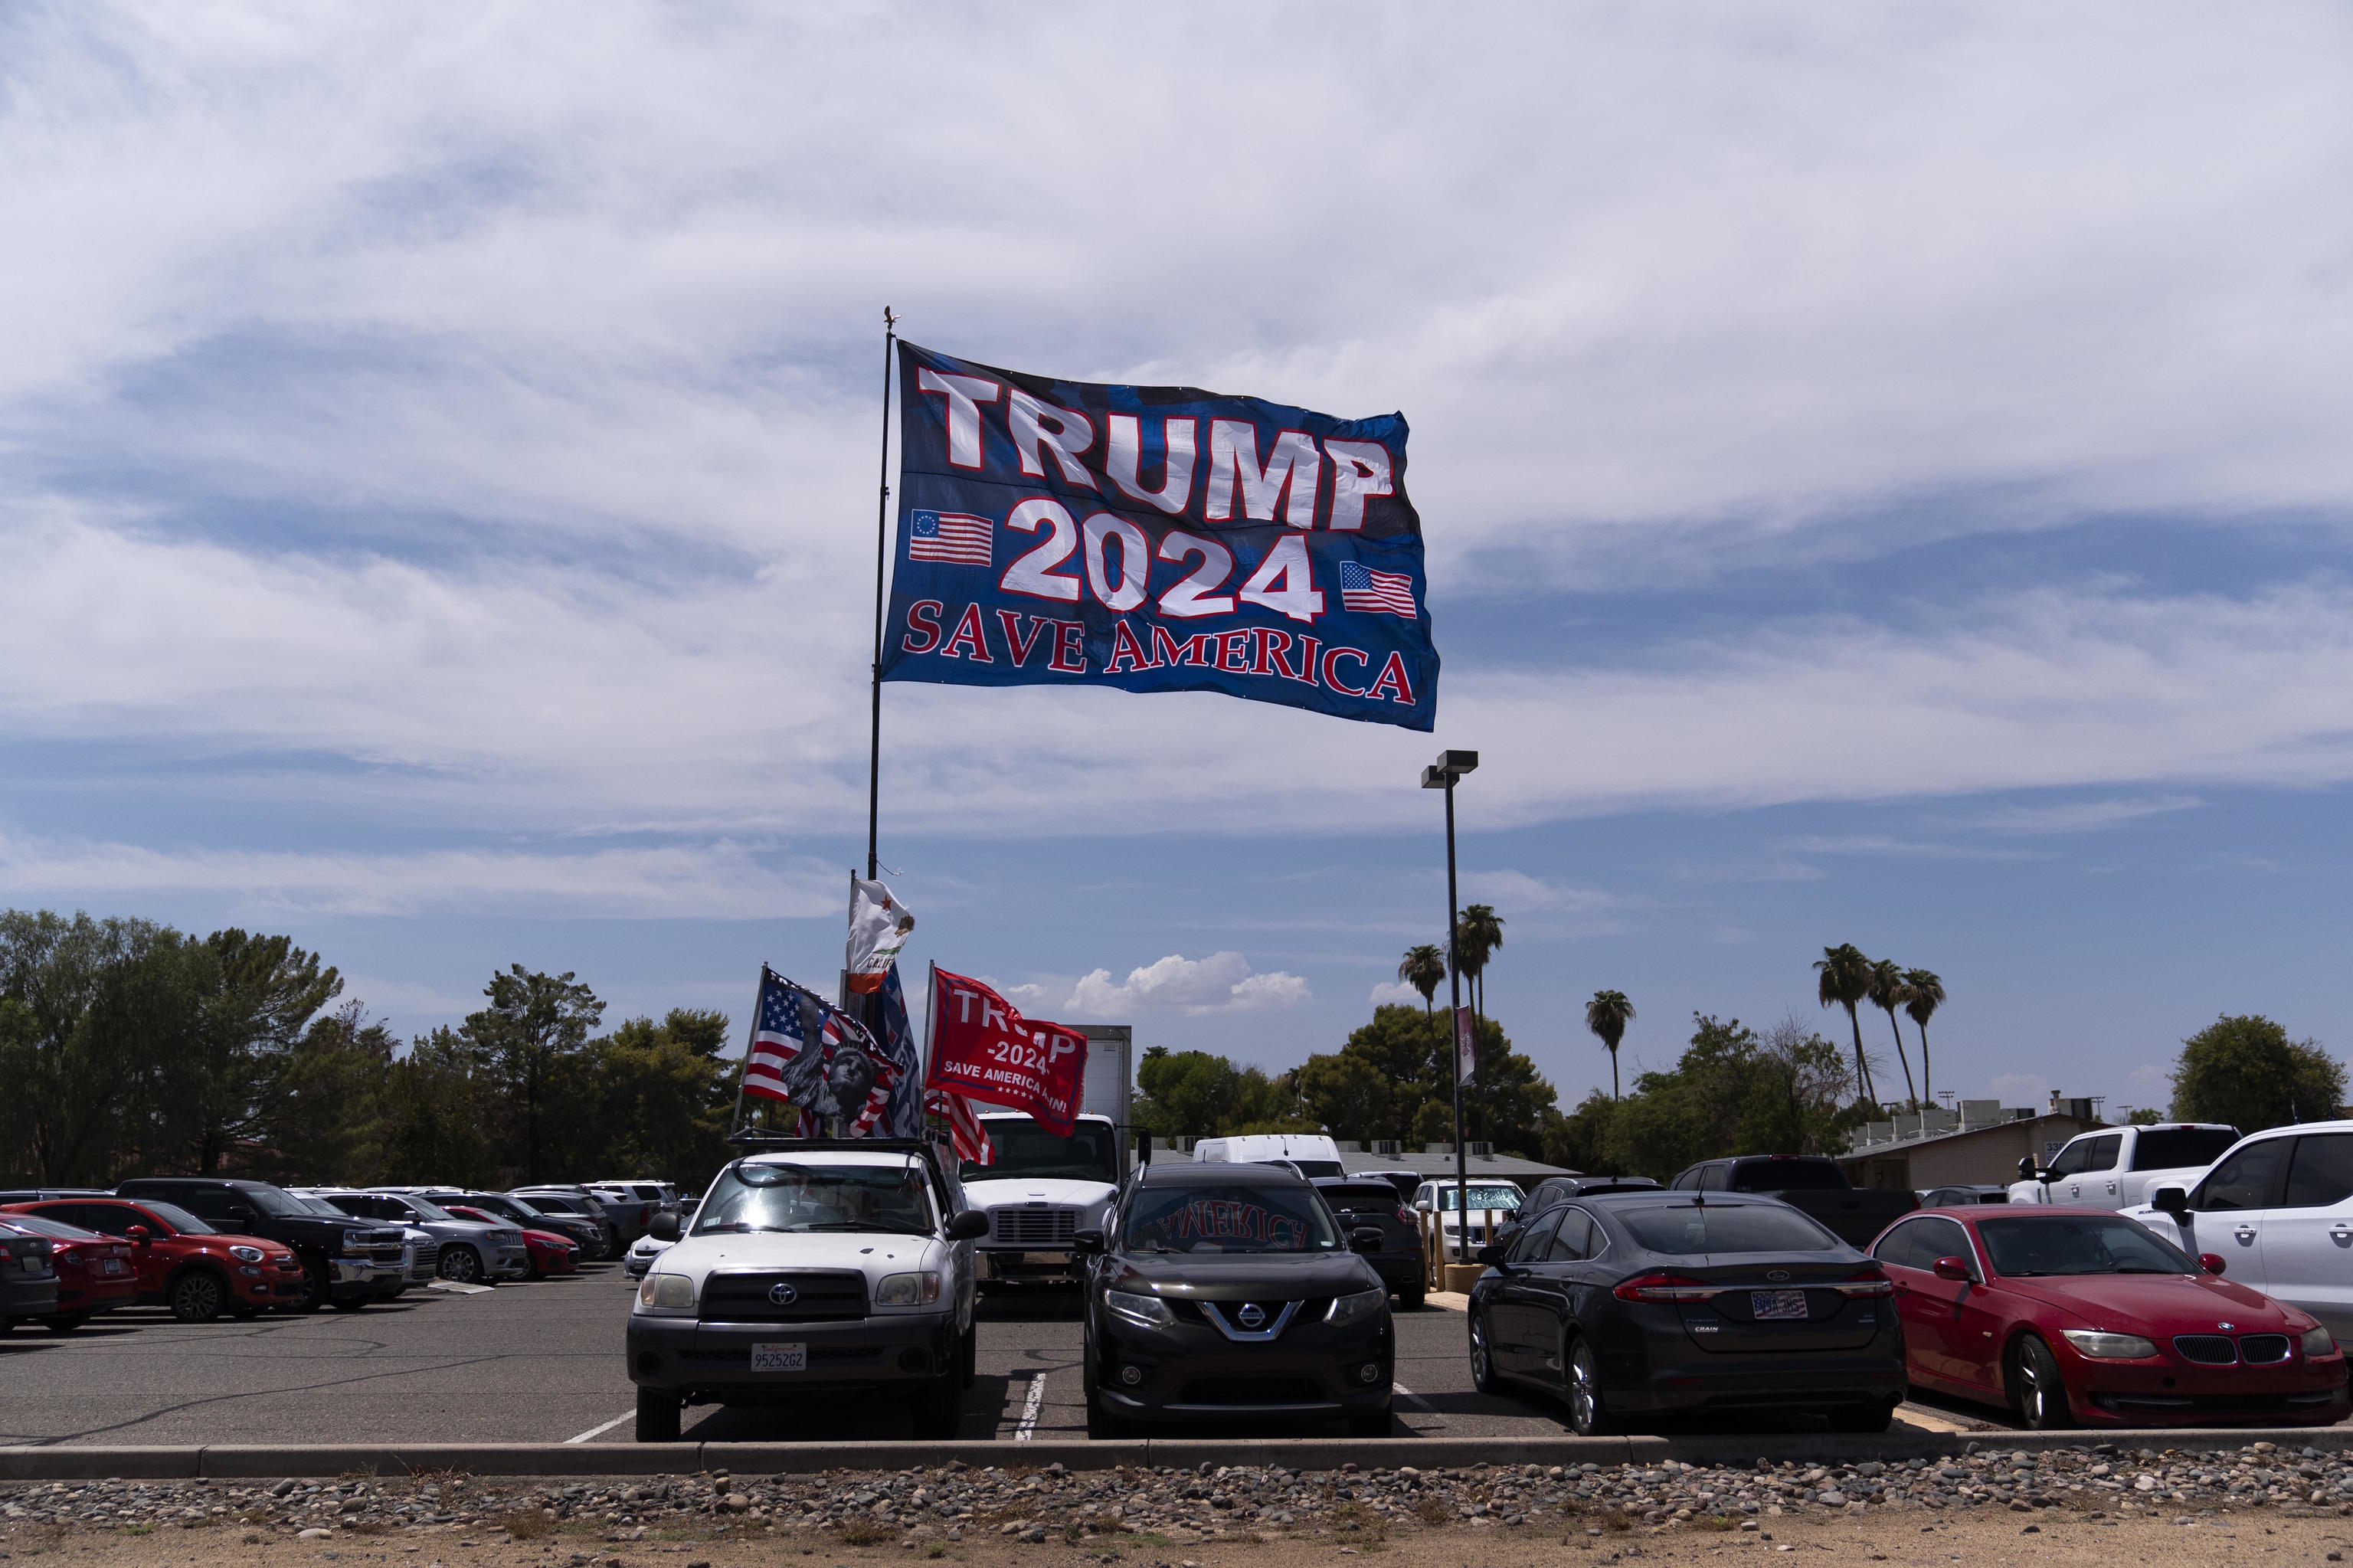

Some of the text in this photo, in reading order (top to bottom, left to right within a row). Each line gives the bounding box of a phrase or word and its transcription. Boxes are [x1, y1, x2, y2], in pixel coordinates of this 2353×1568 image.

[914, 363, 1394, 531] TRUMP
[998, 495, 1325, 624] 2024
[901, 599, 1417, 706] SAVE AMERICA
[954, 989, 1075, 1063] TRP
[944, 1060, 1067, 1113] SAVE AMERICA AIN!
[755, 1353, 803, 1367] 95252G2
